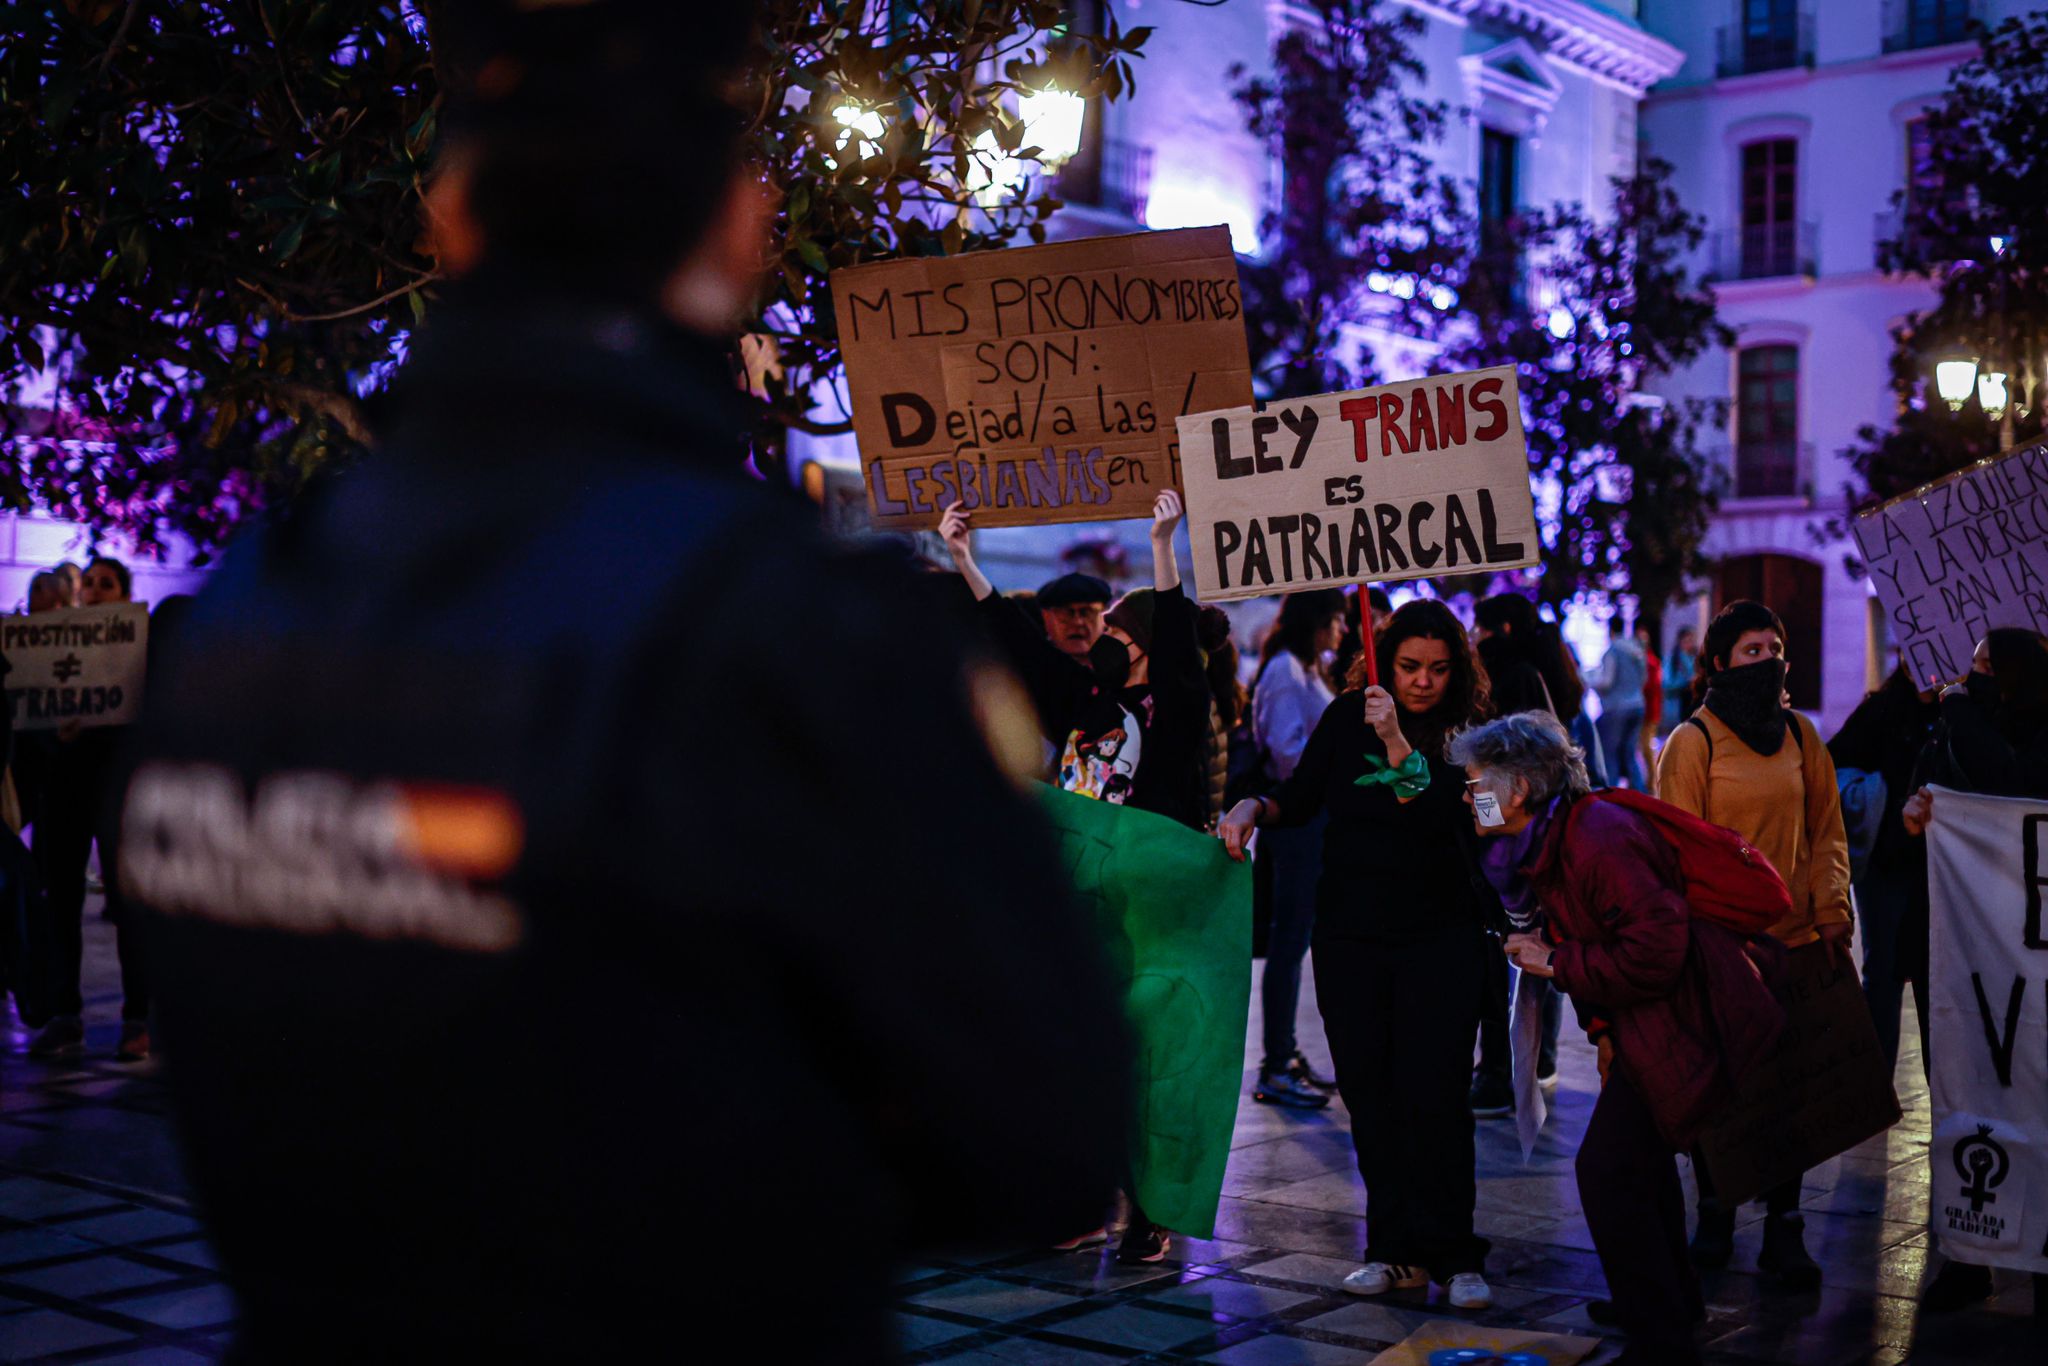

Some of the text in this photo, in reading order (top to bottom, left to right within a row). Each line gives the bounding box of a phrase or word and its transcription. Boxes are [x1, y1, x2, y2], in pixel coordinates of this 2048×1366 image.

[850, 274, 1240, 341] MIS PRONOMBRES
[975, 335, 1100, 384] SON:
[1097, 384, 1157, 434] las
[1211, 405, 1319, 480] LEY
[1339, 377, 1509, 463] TRANS
[1107, 456, 1150, 486] en
[1324, 474, 1365, 506] ES
[1213, 488, 1525, 589] PATRIARCAL
[1853, 513, 1912, 564] LA
[1877, 559, 1905, 599] Y
[1913, 537, 1965, 586] LA
[1893, 594, 1937, 641] SE
[1939, 566, 2002, 623] DAN
[2001, 551, 2045, 597] LA
[1908, 632, 1960, 688] EN
[1945, 1206, 2005, 1230] GRANADA
[1949, 1217, 2000, 1240] RADFEM
